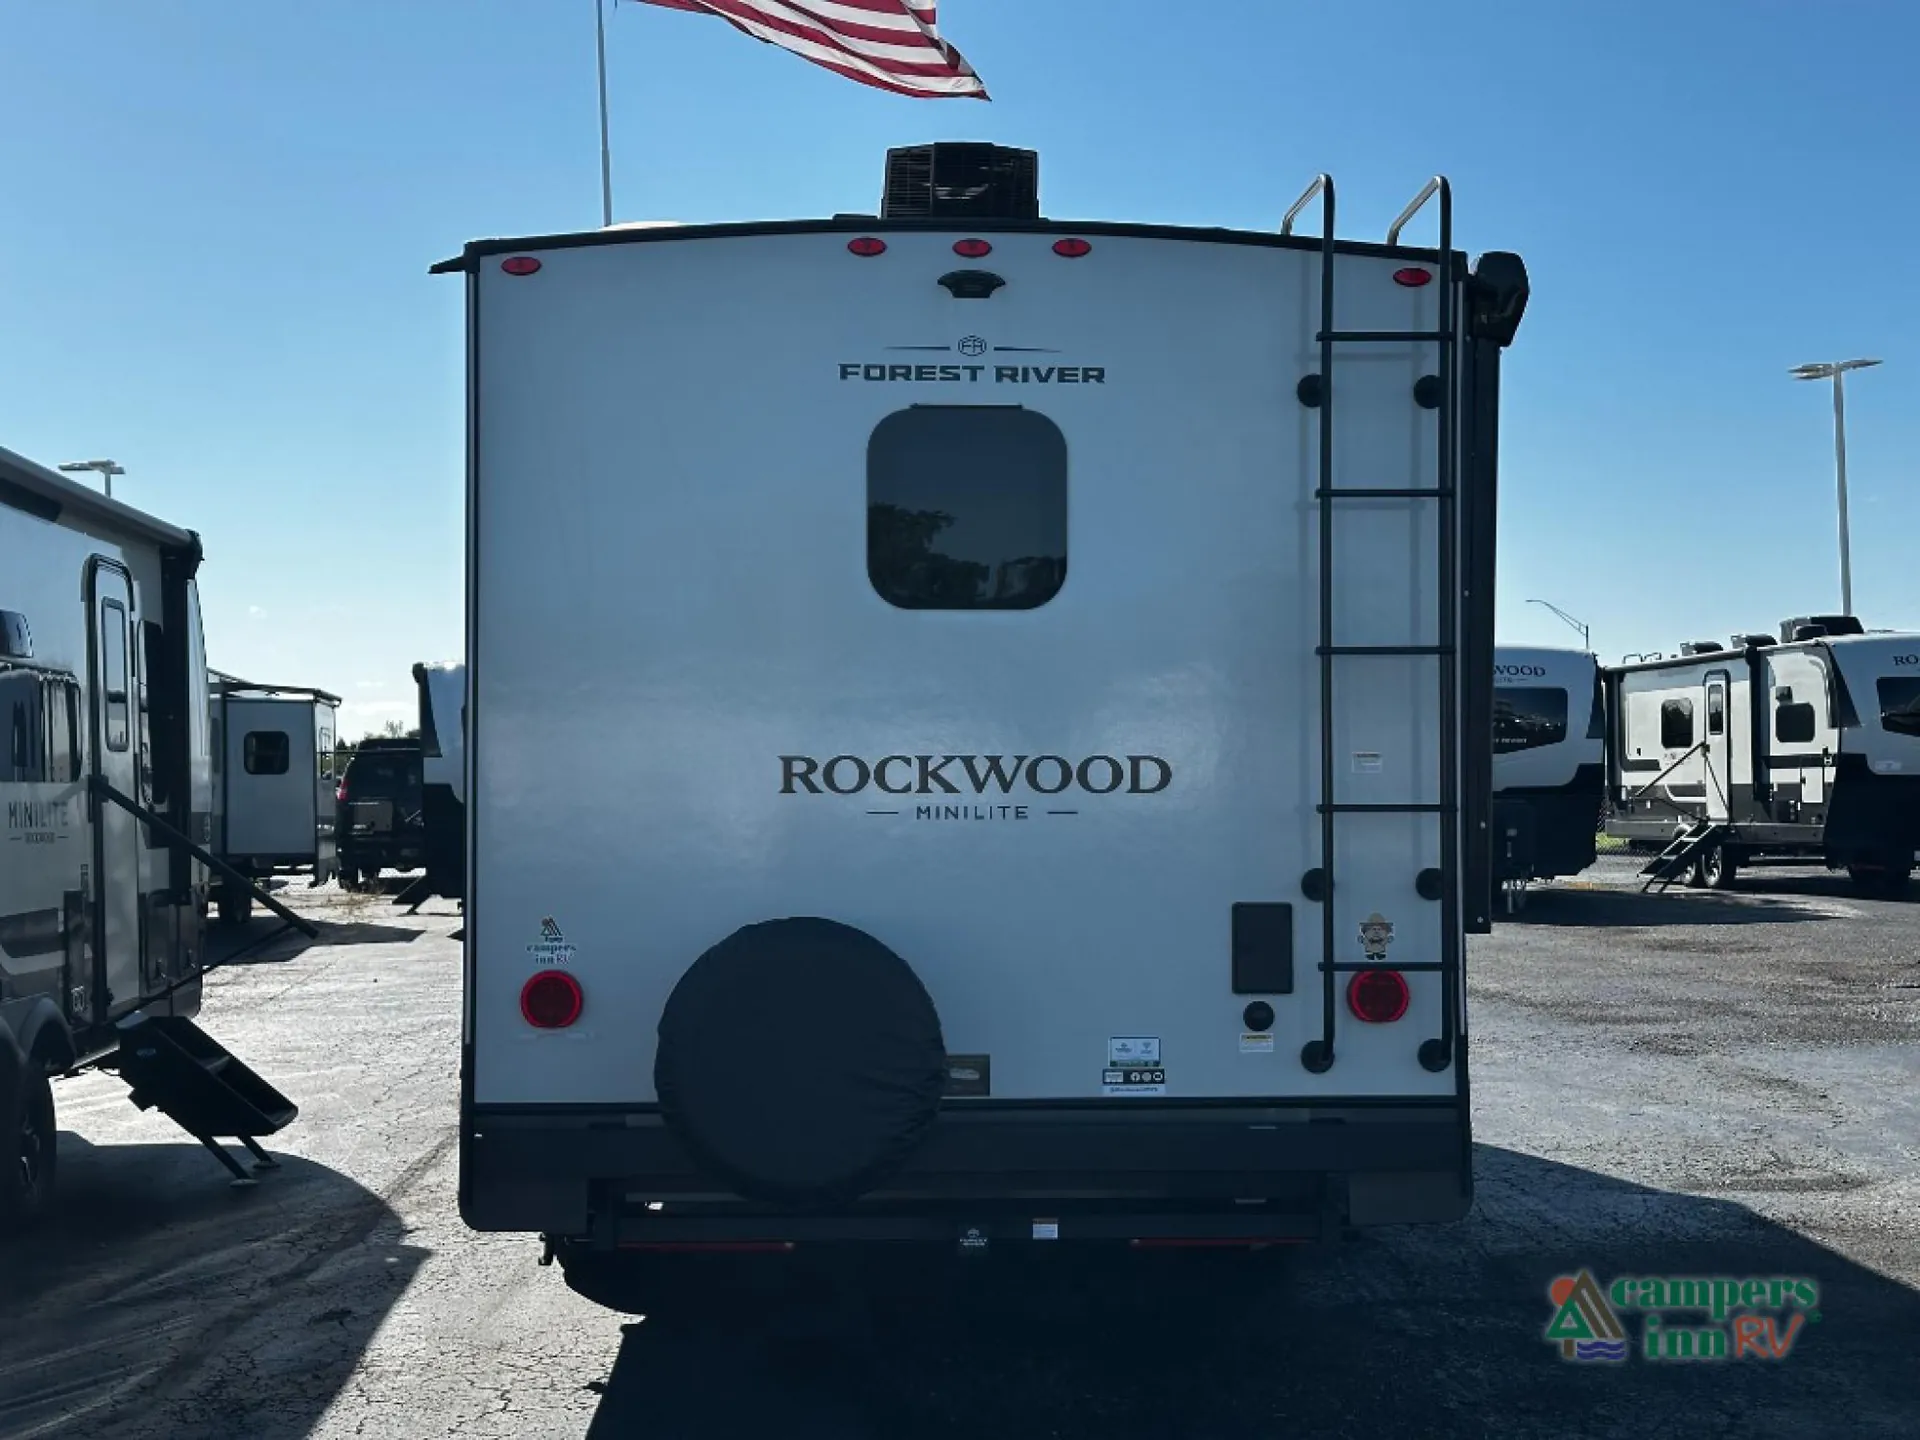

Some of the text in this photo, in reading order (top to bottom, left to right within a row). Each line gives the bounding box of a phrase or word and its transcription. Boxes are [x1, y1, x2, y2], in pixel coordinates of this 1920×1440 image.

[838, 363, 1106, 384] FOREST RIVER
[777, 755, 1173, 794] ROCKWOOD
[916, 805, 1029, 821] MINILITE
